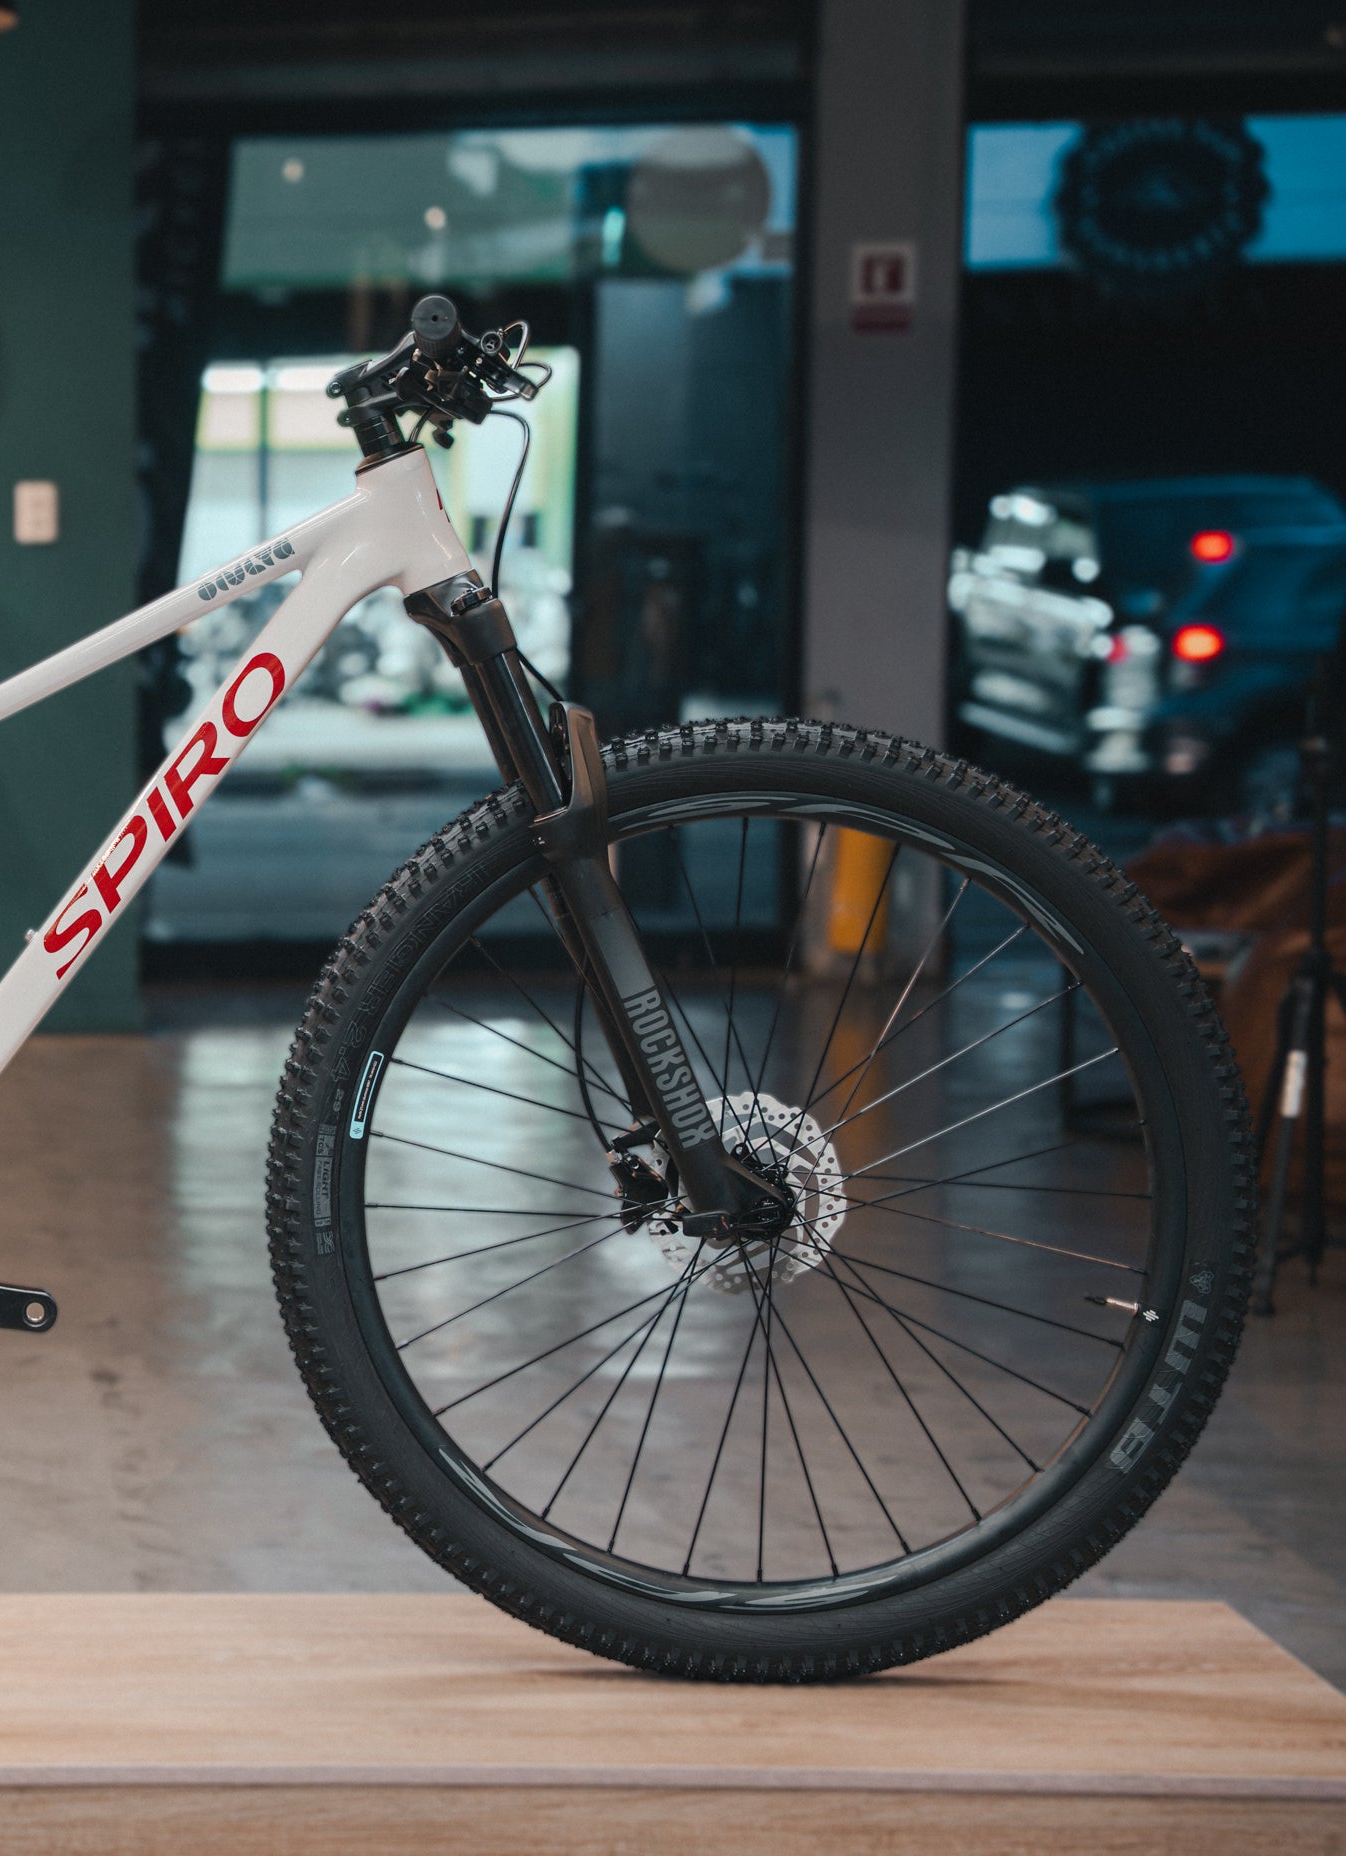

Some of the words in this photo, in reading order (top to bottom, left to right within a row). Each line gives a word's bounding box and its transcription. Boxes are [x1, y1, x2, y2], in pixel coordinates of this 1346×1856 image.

[44, 652, 285, 980] SPIRO
[623, 987, 717, 1150] ROCKSHOX
[321, 1161, 329, 1198] LIGHT
